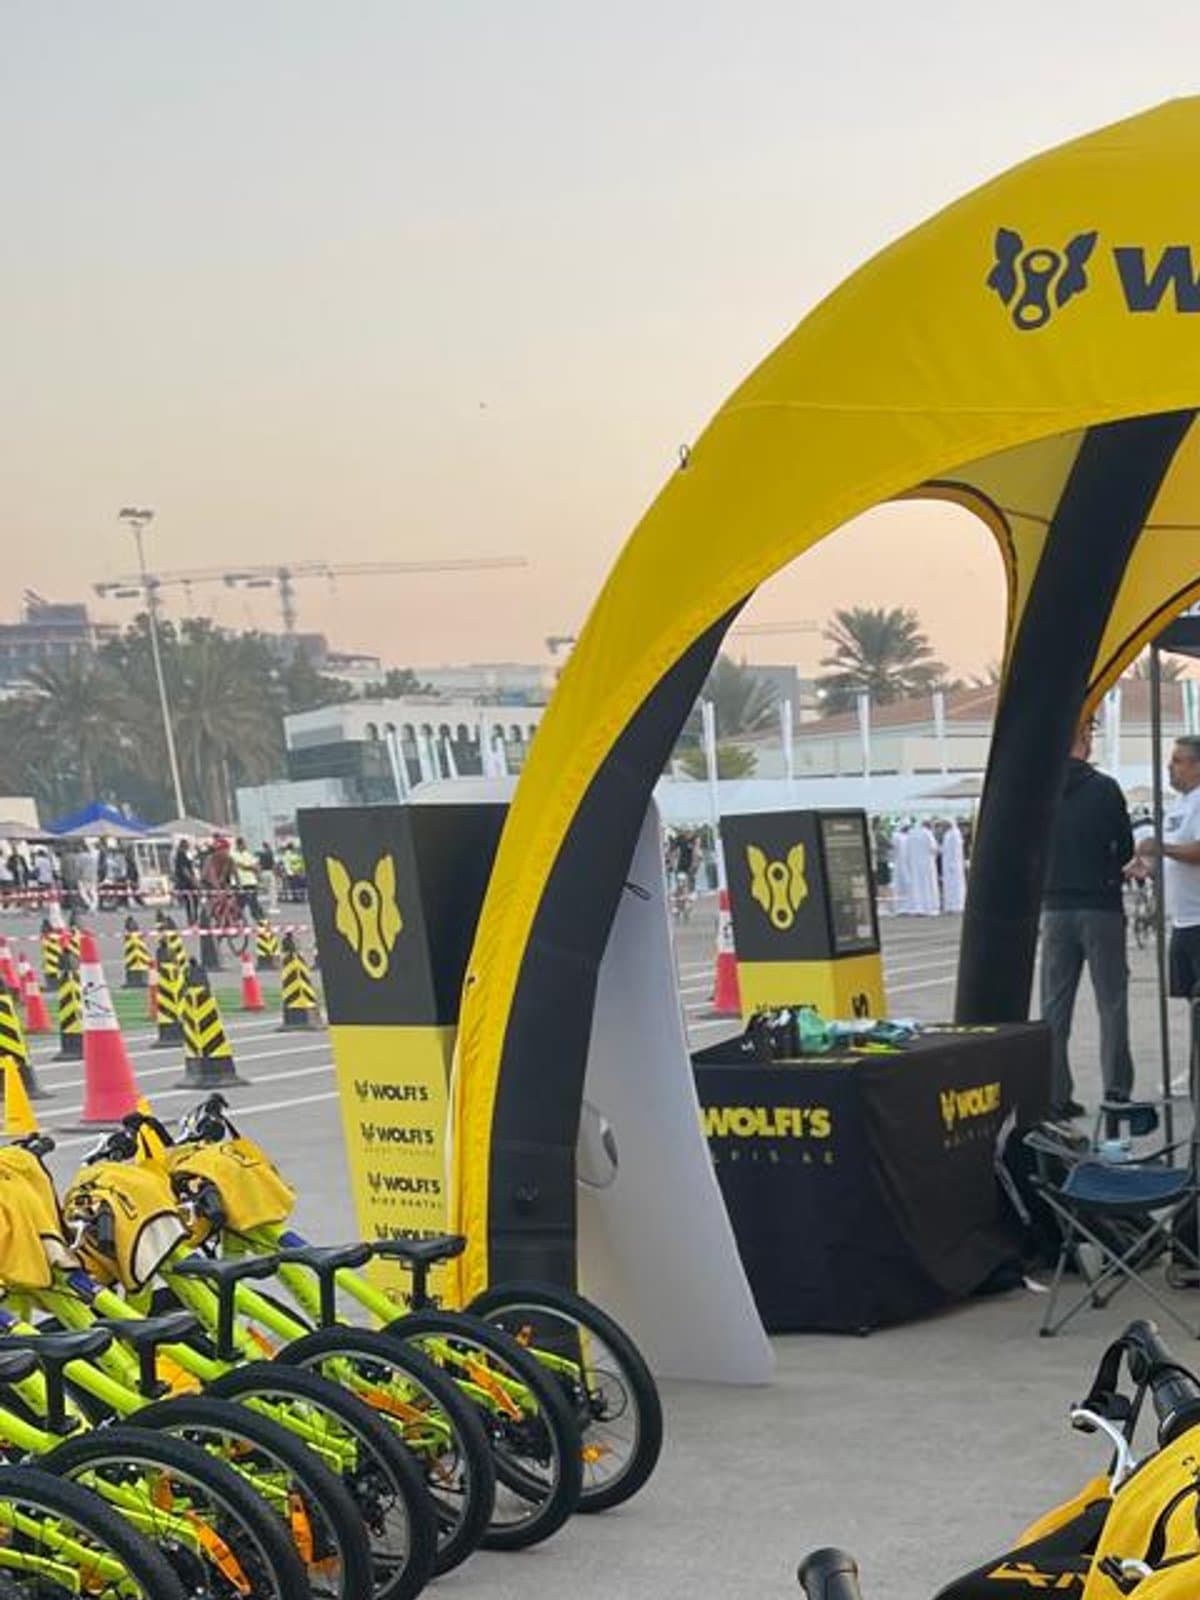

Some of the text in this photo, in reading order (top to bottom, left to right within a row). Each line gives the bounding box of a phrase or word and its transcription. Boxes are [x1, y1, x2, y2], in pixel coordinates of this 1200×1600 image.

[370, 1084, 428, 1101] WOLFI'S
[700, 1107, 832, 1137] WOLFI'S
[377, 1126, 434, 1144] WOLFI'S
[383, 1176, 441, 1195] WOLFI'S
